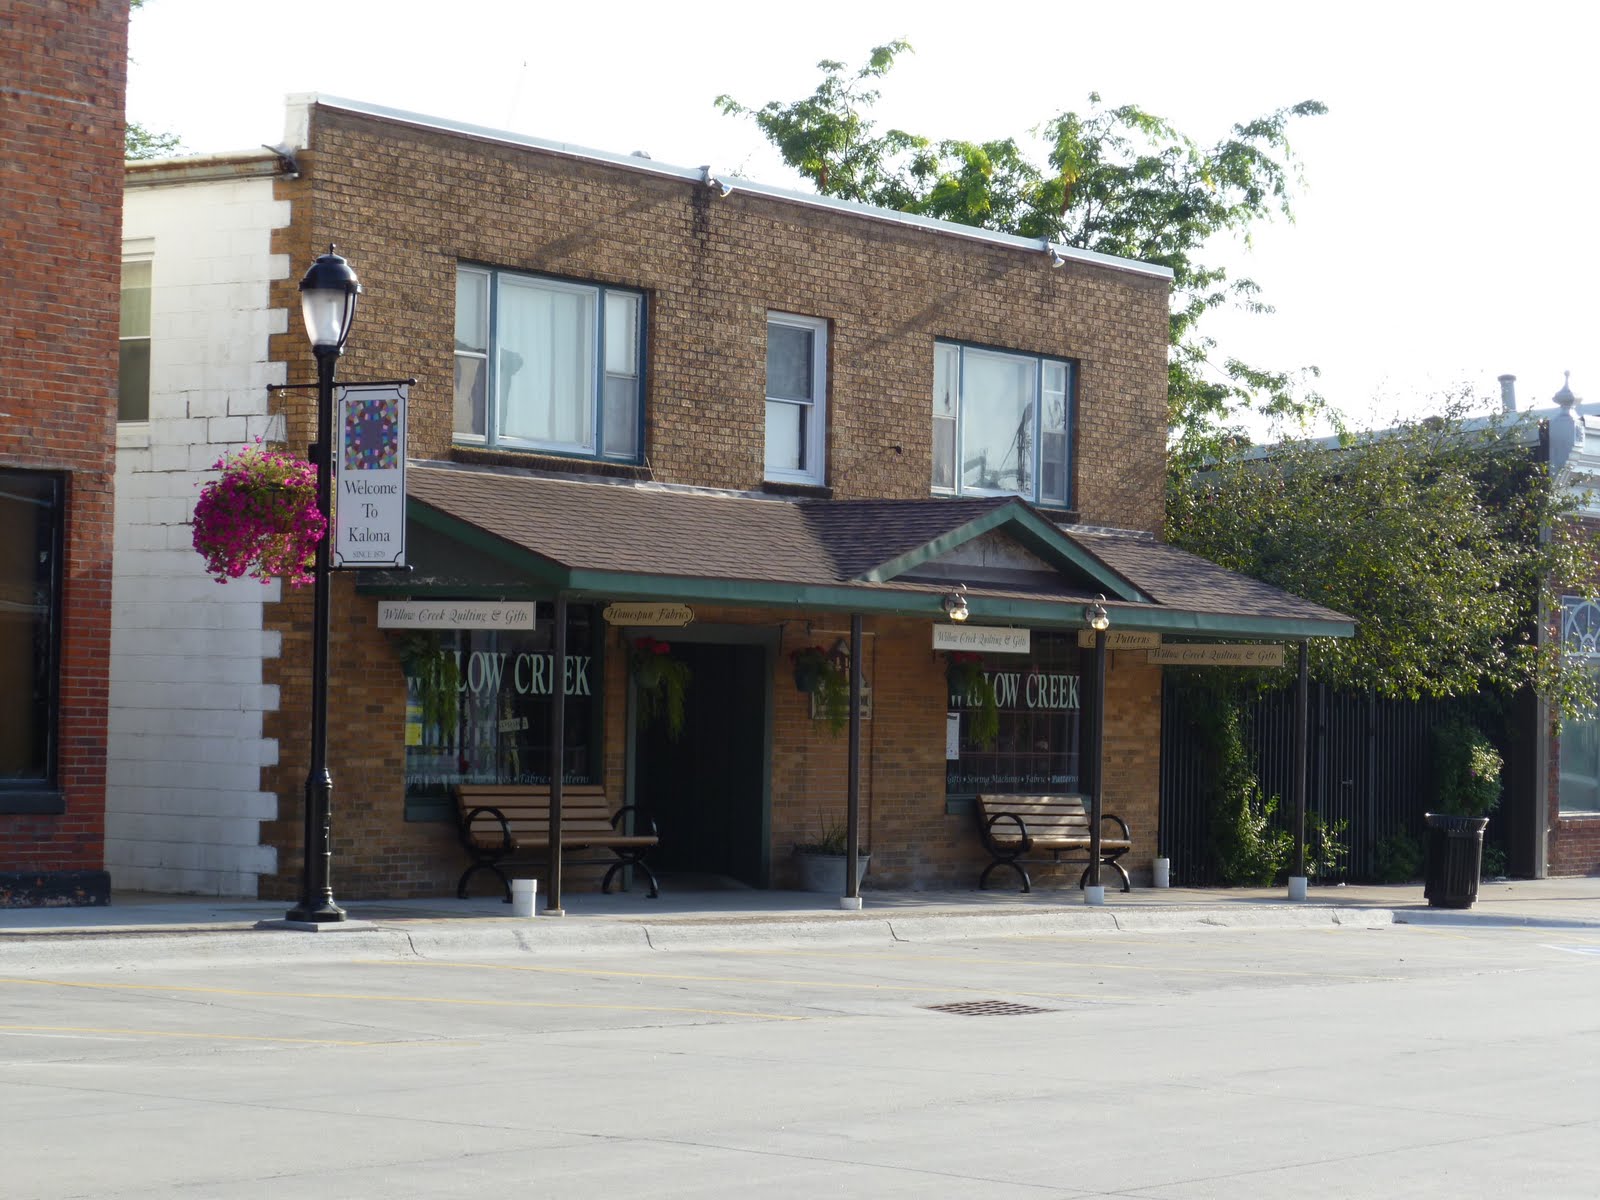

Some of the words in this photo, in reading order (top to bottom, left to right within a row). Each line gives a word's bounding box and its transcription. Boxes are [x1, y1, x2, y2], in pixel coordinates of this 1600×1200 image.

[344, 480, 398, 495] Welcome
[361, 503, 378, 519] To
[348, 527, 391, 542] Kalona
[352, 550, 372, 558] SINCE
[383, 608, 415, 621] Willow
[418, 608, 446, 622] Creek
[450, 608, 487, 624] Quilting
[491, 609, 502, 622] &
[505, 609, 528, 625] Gifts
[607, 607, 654, 621] Homespun
[656, 607, 690, 622] Fabrics
[937, 631, 958, 643] Willow
[959, 631, 977, 644] Creek
[978, 632, 1003, 646] Quilting
[1003, 634, 1012, 645] &
[1012, 634, 1027, 648] Gifts
[1115, 633, 1151, 644] Patterns
[1153, 648, 1178, 659] Willow
[1182, 649, 1205, 660] Creek
[1210, 649, 1242, 661] Quilting
[1245, 650, 1255, 660] &
[1257, 650, 1278, 662] Gifts
[1026, 673, 1080, 709] CREEK
[1050, 774, 1080, 784] Patterns
